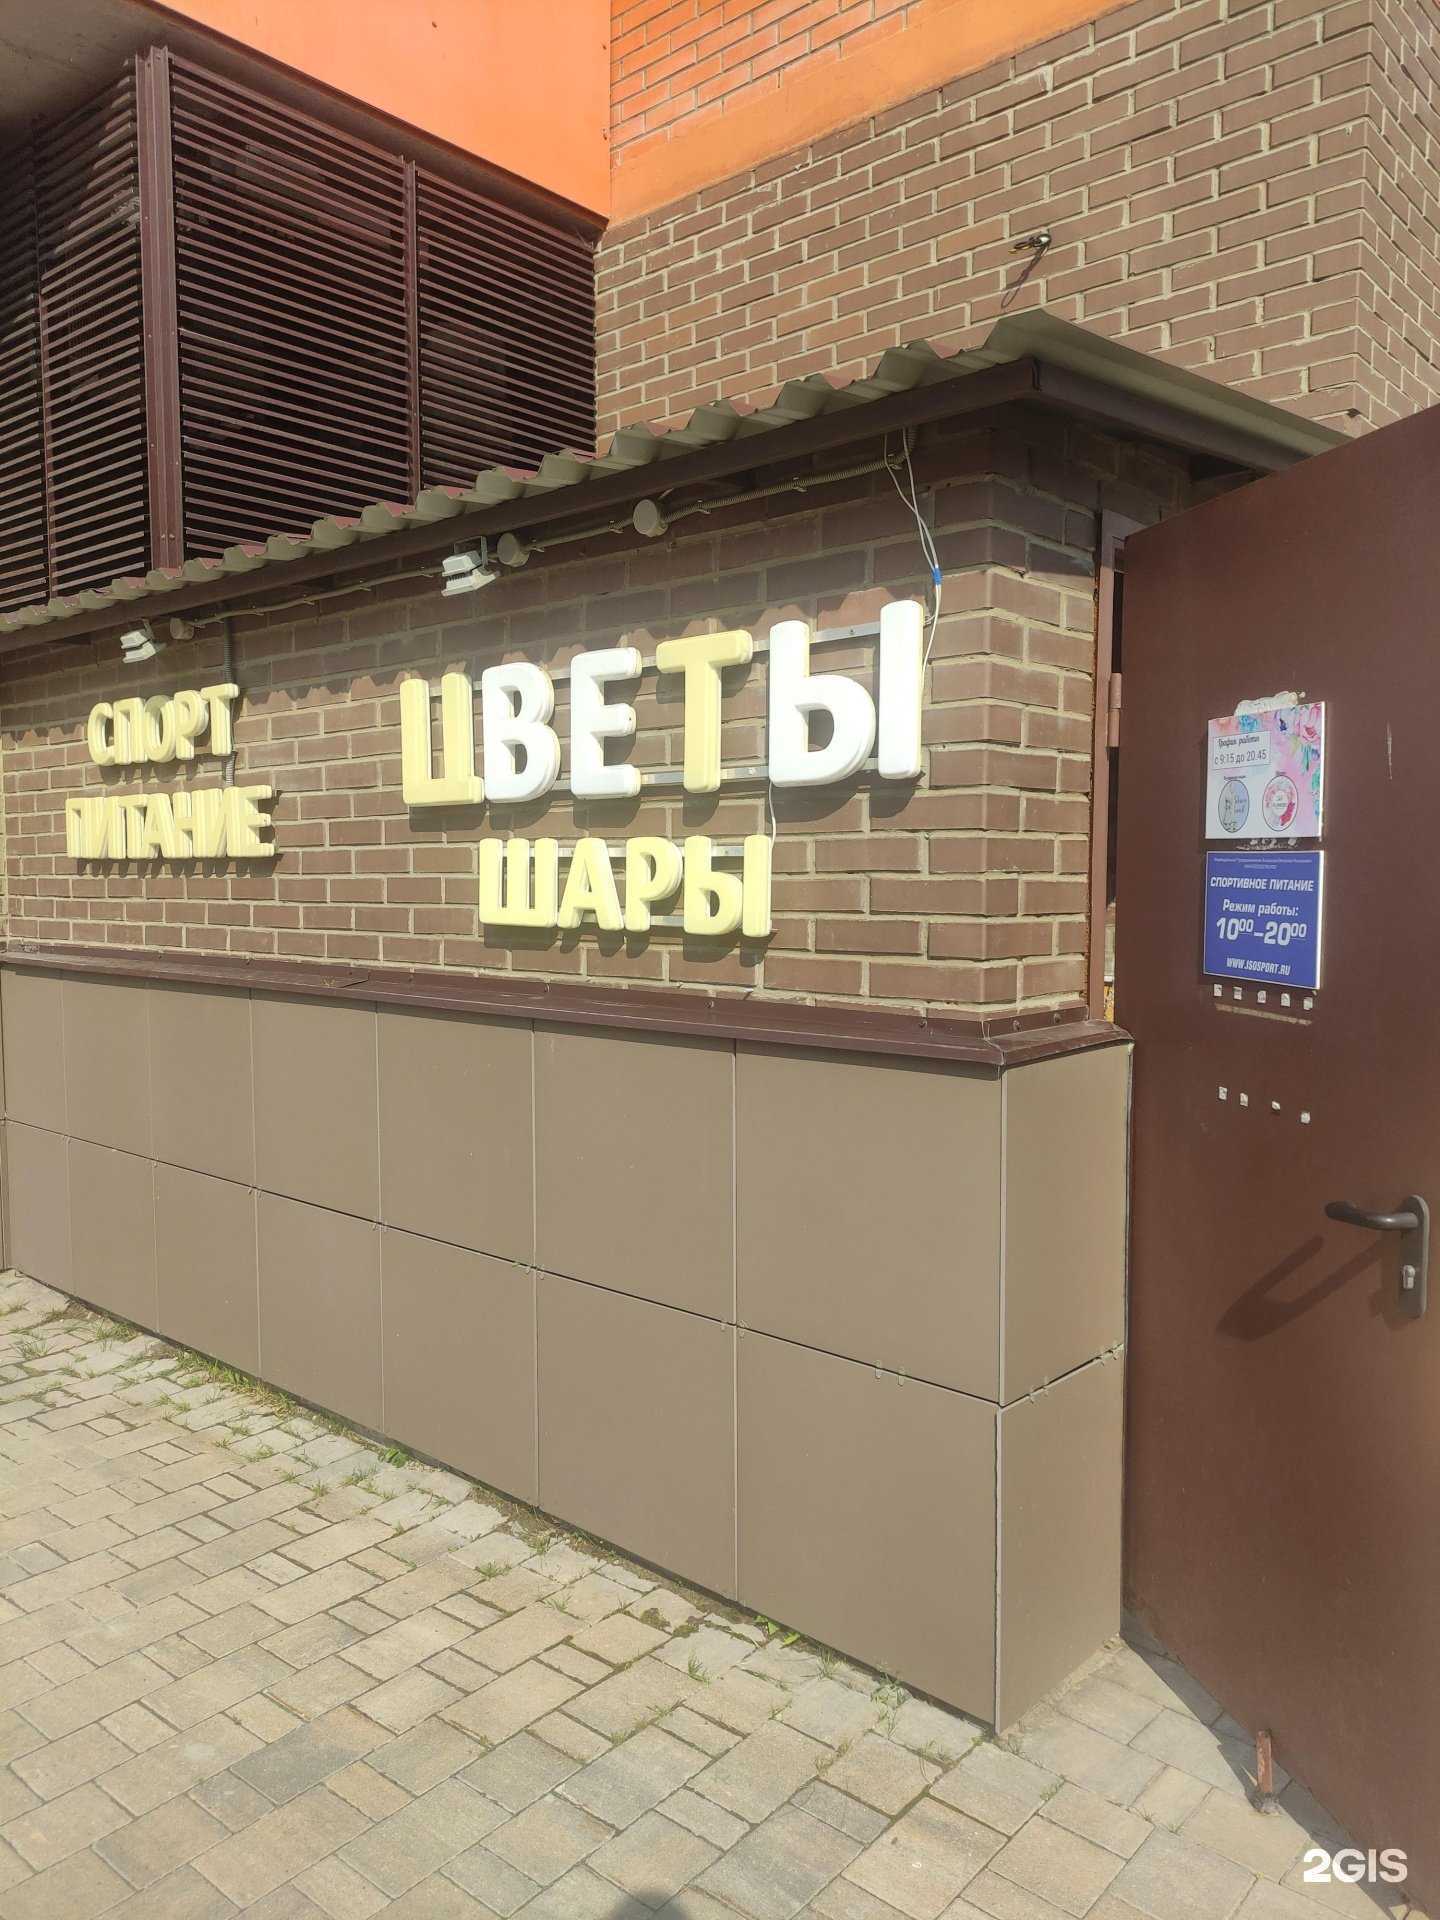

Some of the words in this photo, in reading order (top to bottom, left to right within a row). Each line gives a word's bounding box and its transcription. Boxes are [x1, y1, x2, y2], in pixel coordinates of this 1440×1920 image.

[87, 683, 239, 767] СПОРТ
[399, 599, 925, 807] ЦВЕТЫ
[65, 783, 278, 861] ПИТАНИЕ
[478, 834, 774, 940] ШАРЫ
[1210, 876, 1267, 890] СПОРТИВНОЕ
[1269, 878, 1314, 892] ПИТАНИЕ
[1222, 898, 1255, 914] Режим
[1258, 901, 1299, 917] работы:
